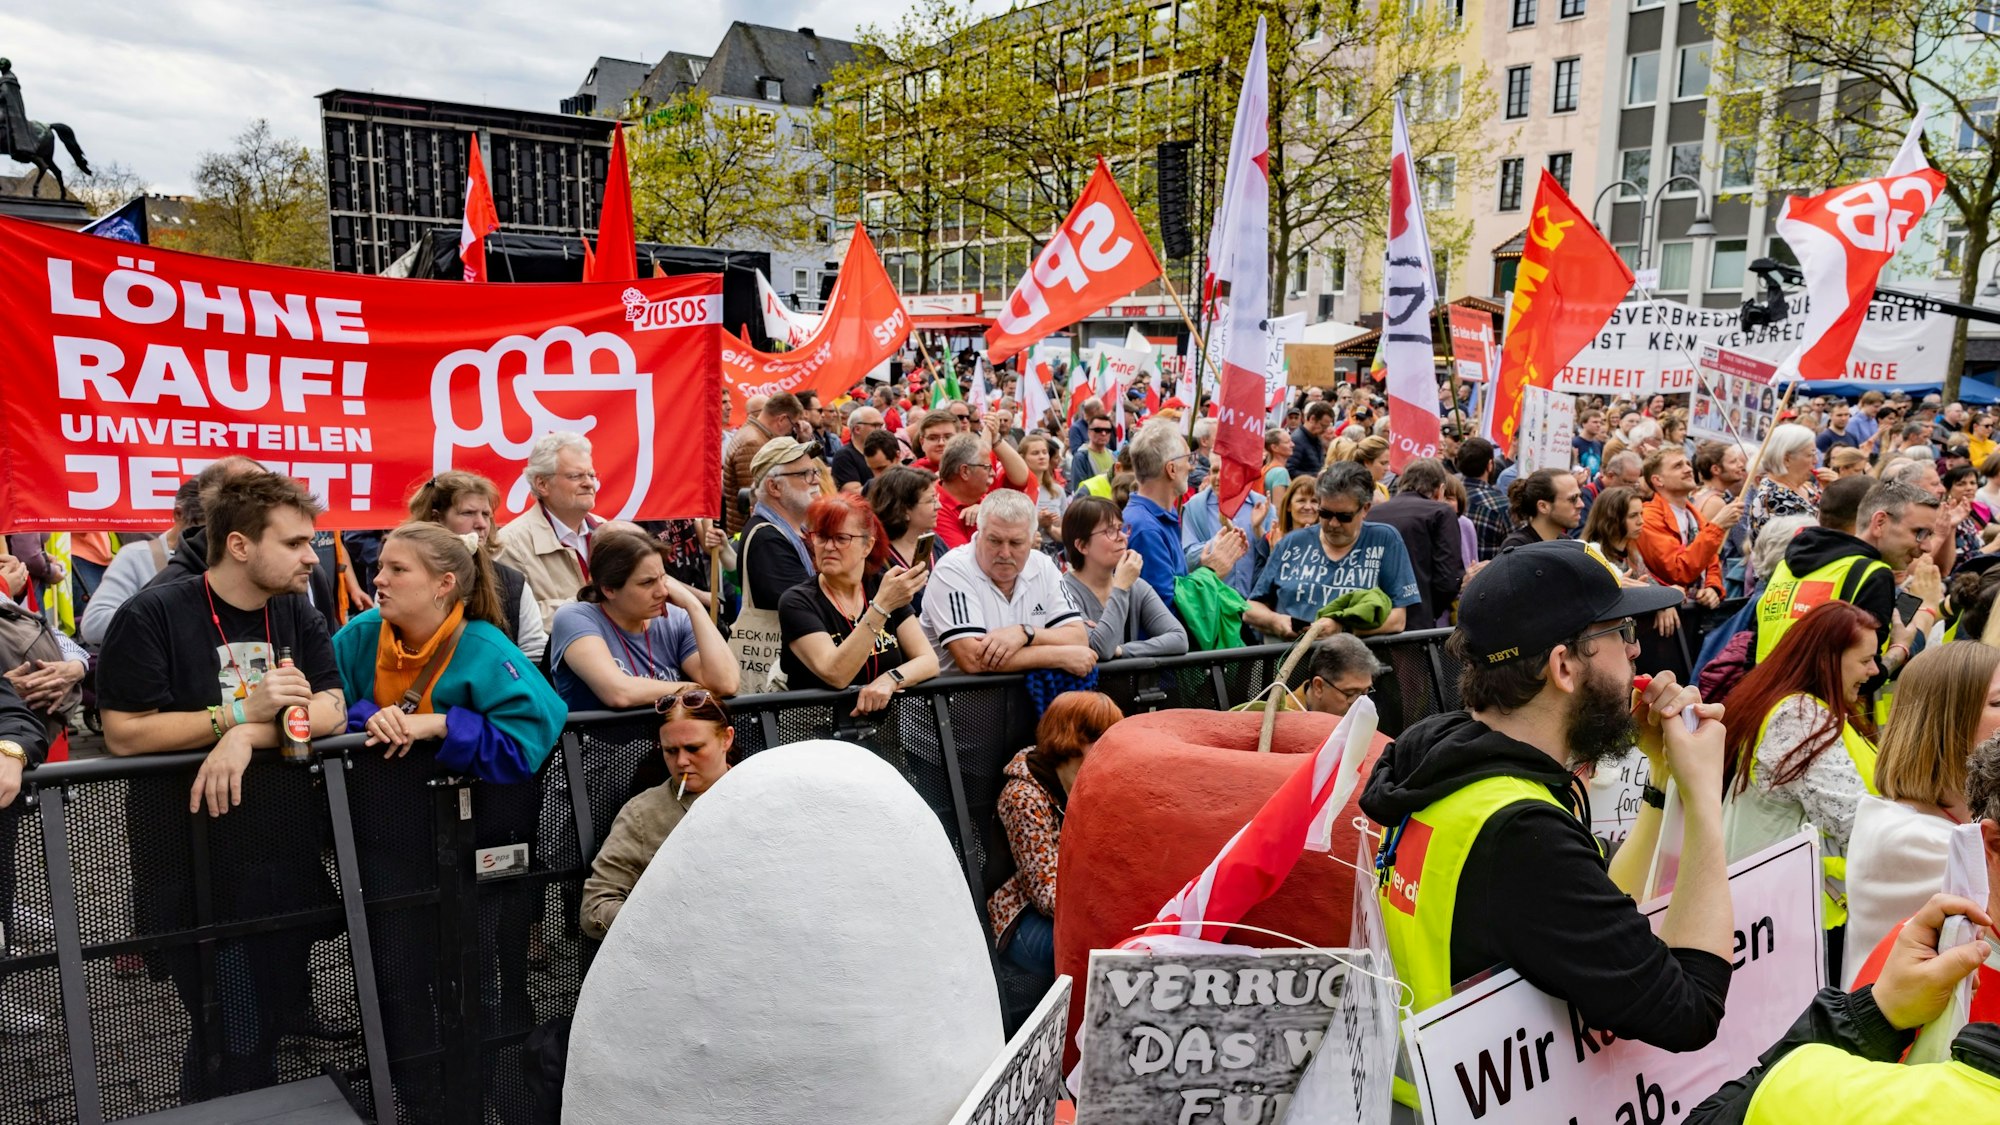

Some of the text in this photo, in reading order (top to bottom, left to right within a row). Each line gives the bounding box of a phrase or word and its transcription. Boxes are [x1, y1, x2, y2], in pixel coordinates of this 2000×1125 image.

[46, 256, 370, 345] LÖHNE
[642, 298, 707, 328] JUSOS
[873, 307, 905, 346] SPD
[1610, 304, 1738, 327] SVERBRECH
[1648, 331, 1698, 351] KEIN
[1717, 322, 1803, 348] VERBREC
[52, 336, 368, 415] RAUF!
[1562, 366, 1646, 389] REIHEIT
[1660, 368, 1694, 389] FÜR
[60, 413, 372, 453] UMVERTEILEN
[64, 454, 373, 512] JET!
[1280, 562, 1328, 582] CAMP
[1764, 601, 1786, 615] KEIN
[1765, 589, 1790, 604] UNS
[730, 629, 763, 641] LECK
[743, 645, 760, 657] EN
[1486, 646, 1520, 664] RBTV
[740, 659, 771, 674] TÄSC
[1105, 958, 1349, 1011] VERRÜC
[1128, 1025, 1258, 1077] DAS
[1454, 1026, 1555, 1120] Wir
[1615, 1072, 1681, 1125] ab.
